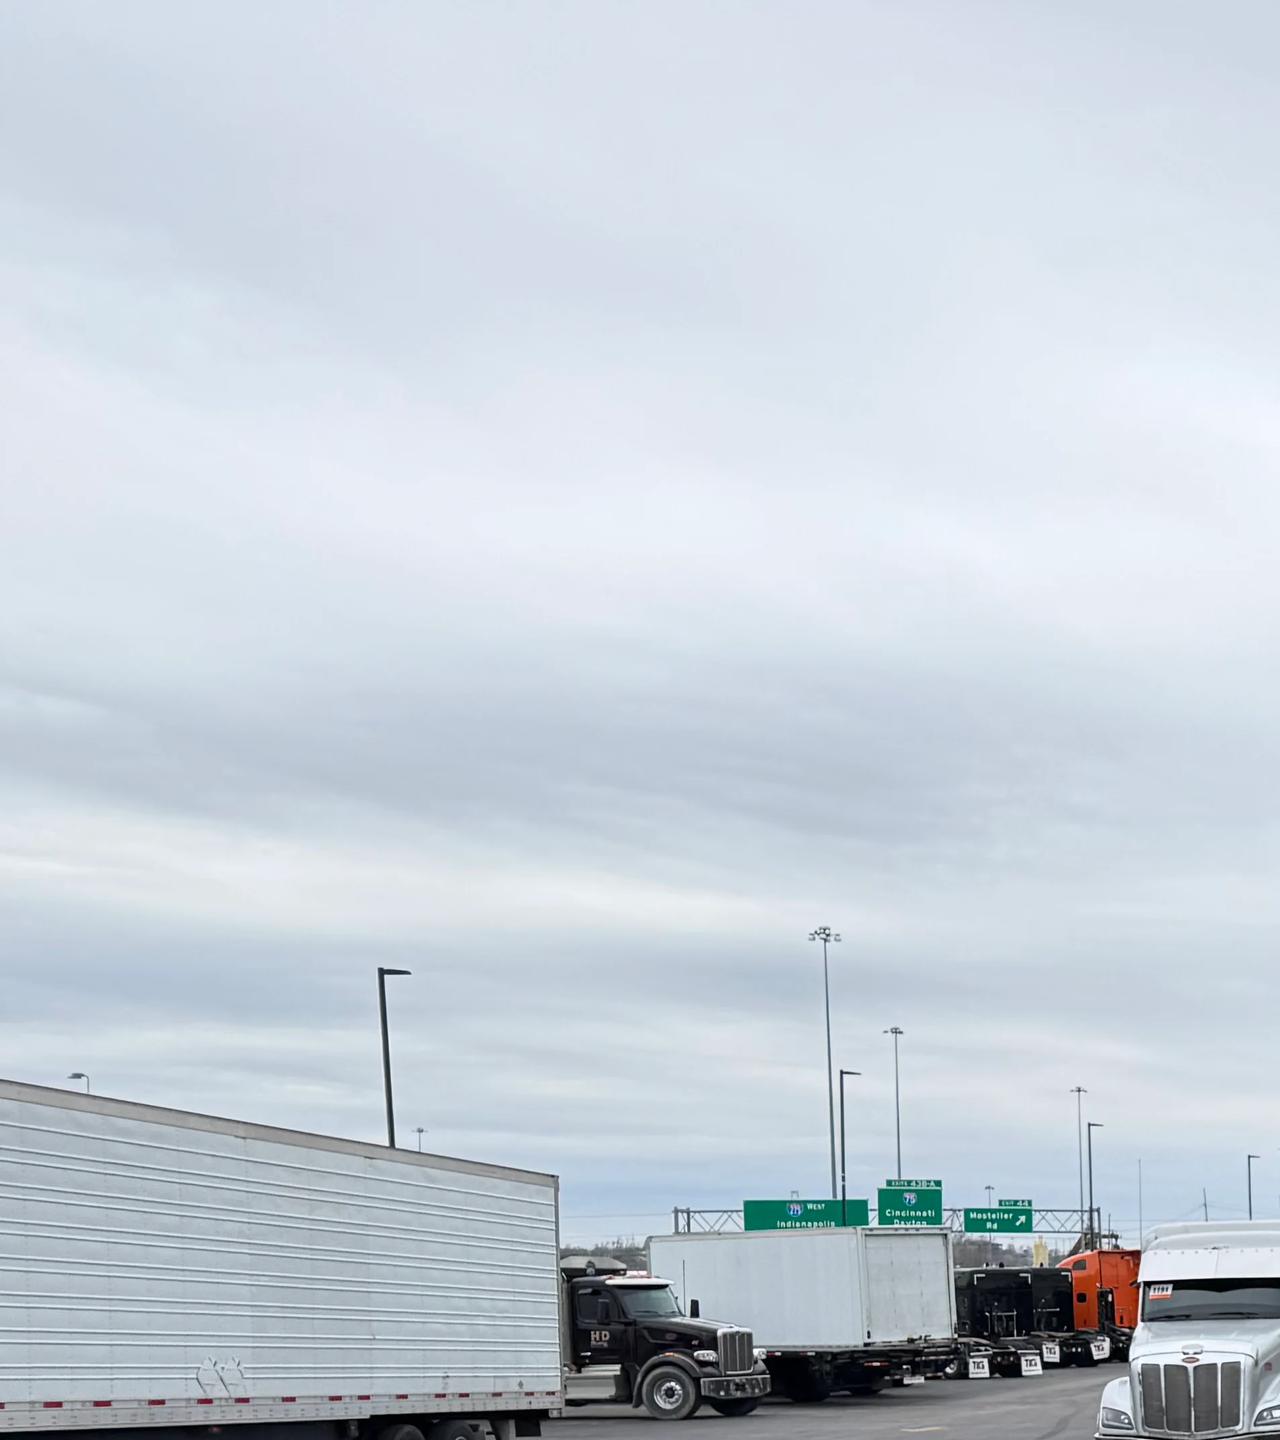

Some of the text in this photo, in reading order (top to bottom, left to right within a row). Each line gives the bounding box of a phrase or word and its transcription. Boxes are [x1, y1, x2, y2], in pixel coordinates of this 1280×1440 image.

[885, 1209, 935, 1217] Cincinnati
[970, 1211, 1013, 1220] Mosteller
[777, 1220, 835, 1229] Indianapolis
[986, 1221, 998, 1230] Rd
